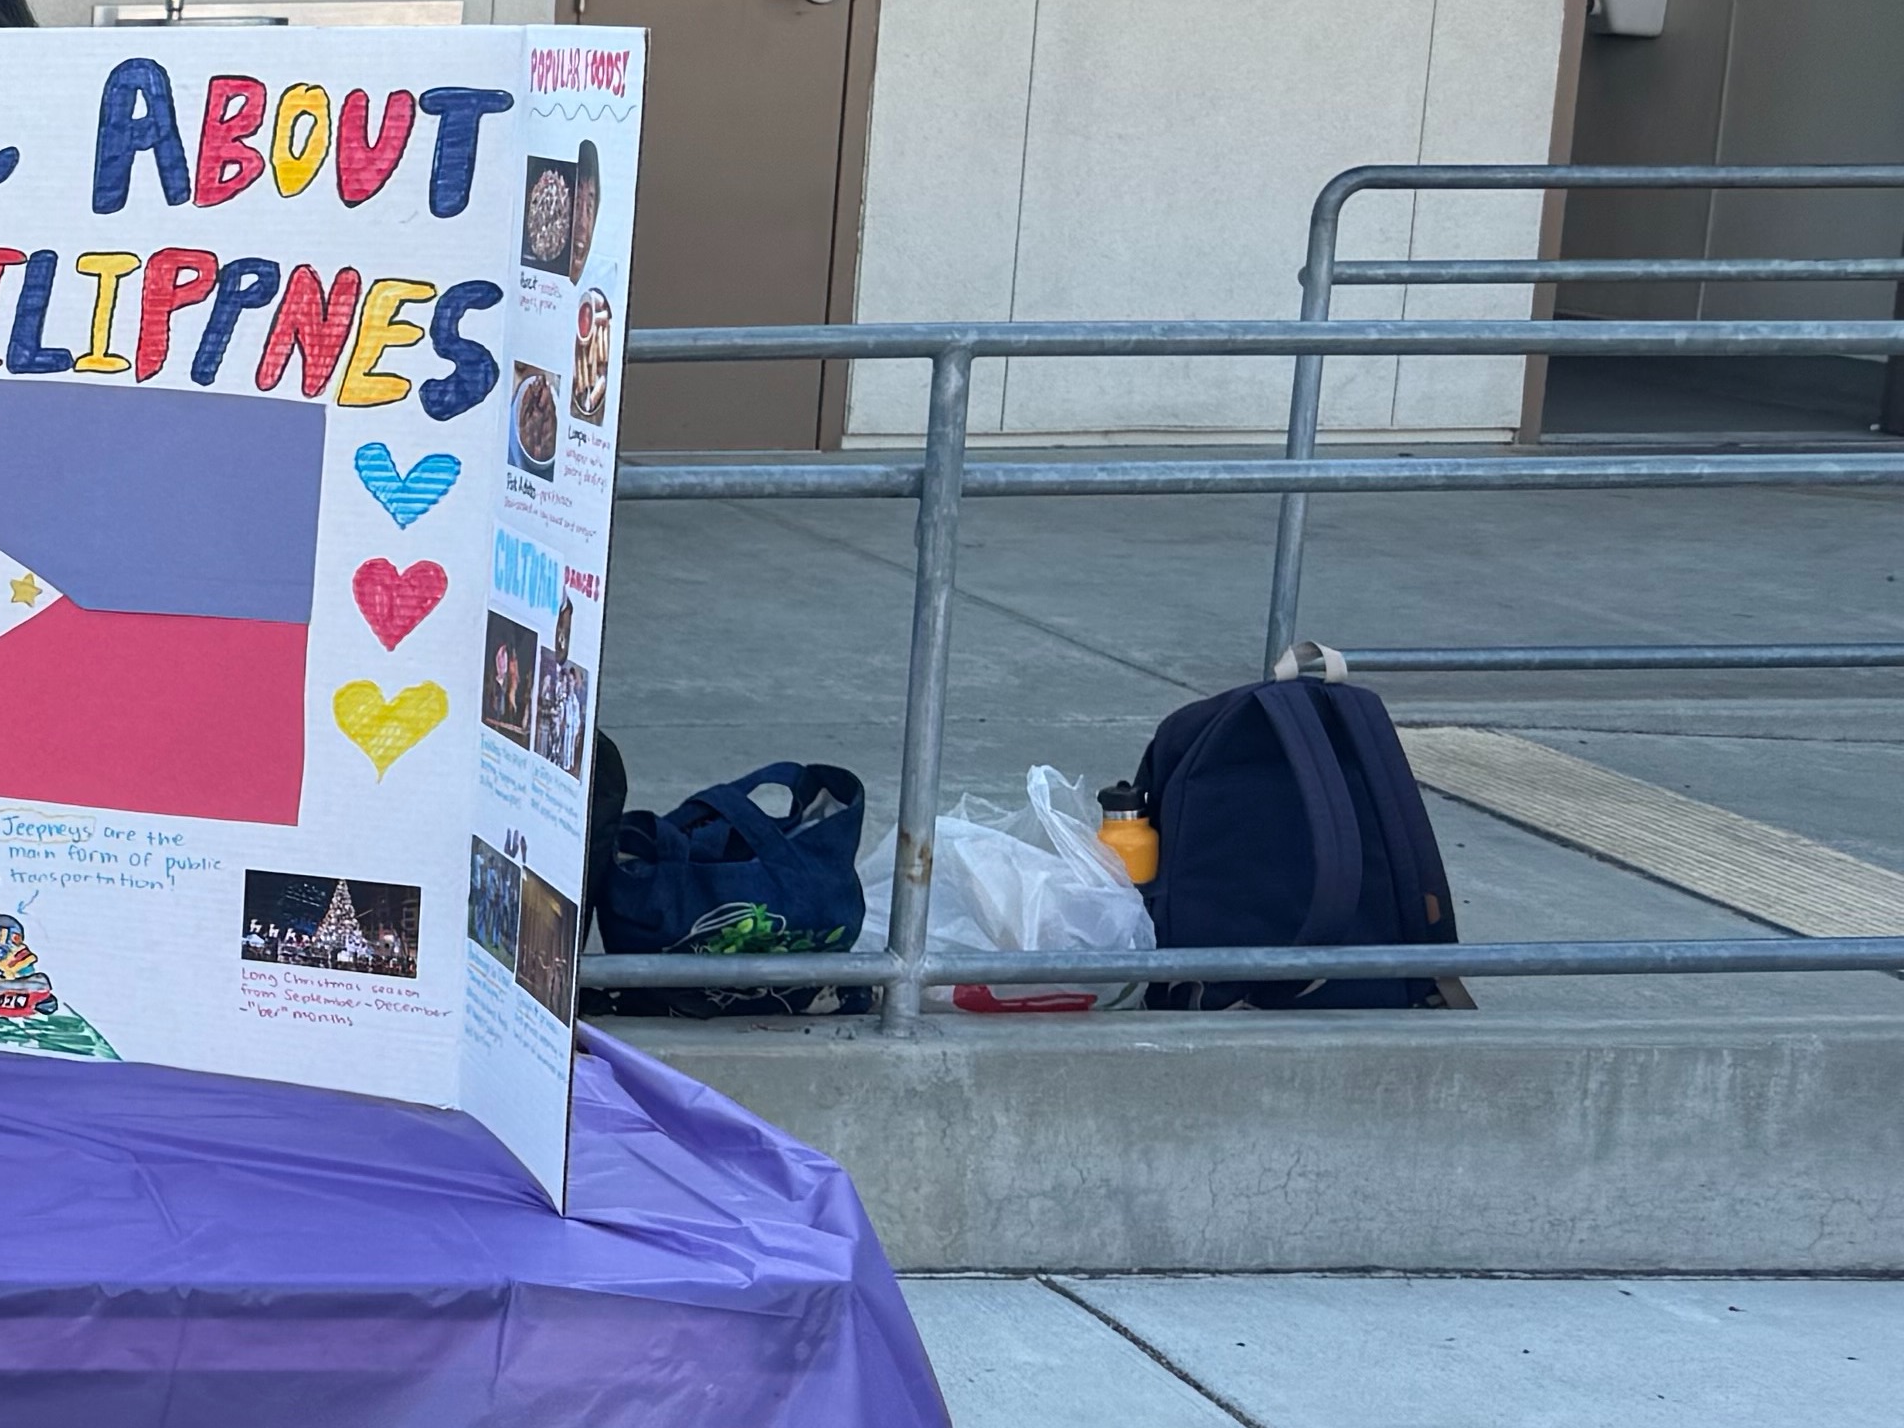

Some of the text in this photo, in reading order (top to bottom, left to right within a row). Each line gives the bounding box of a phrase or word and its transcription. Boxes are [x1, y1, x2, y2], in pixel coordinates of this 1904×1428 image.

[530, 48, 580, 94] POPULAR
[92, 57, 514, 218] ABOUT
[494, 528, 558, 616] CULTURAL
[2, 816, 186, 847] Jeepneys are the
[9, 846, 56, 860] main
[68, 845, 118, 864] form
[165, 856, 225, 878] public
[241, 967, 420, 999] Long Christmas season
[241, 984, 276, 999] from
[293, 1010, 353, 1027] months
